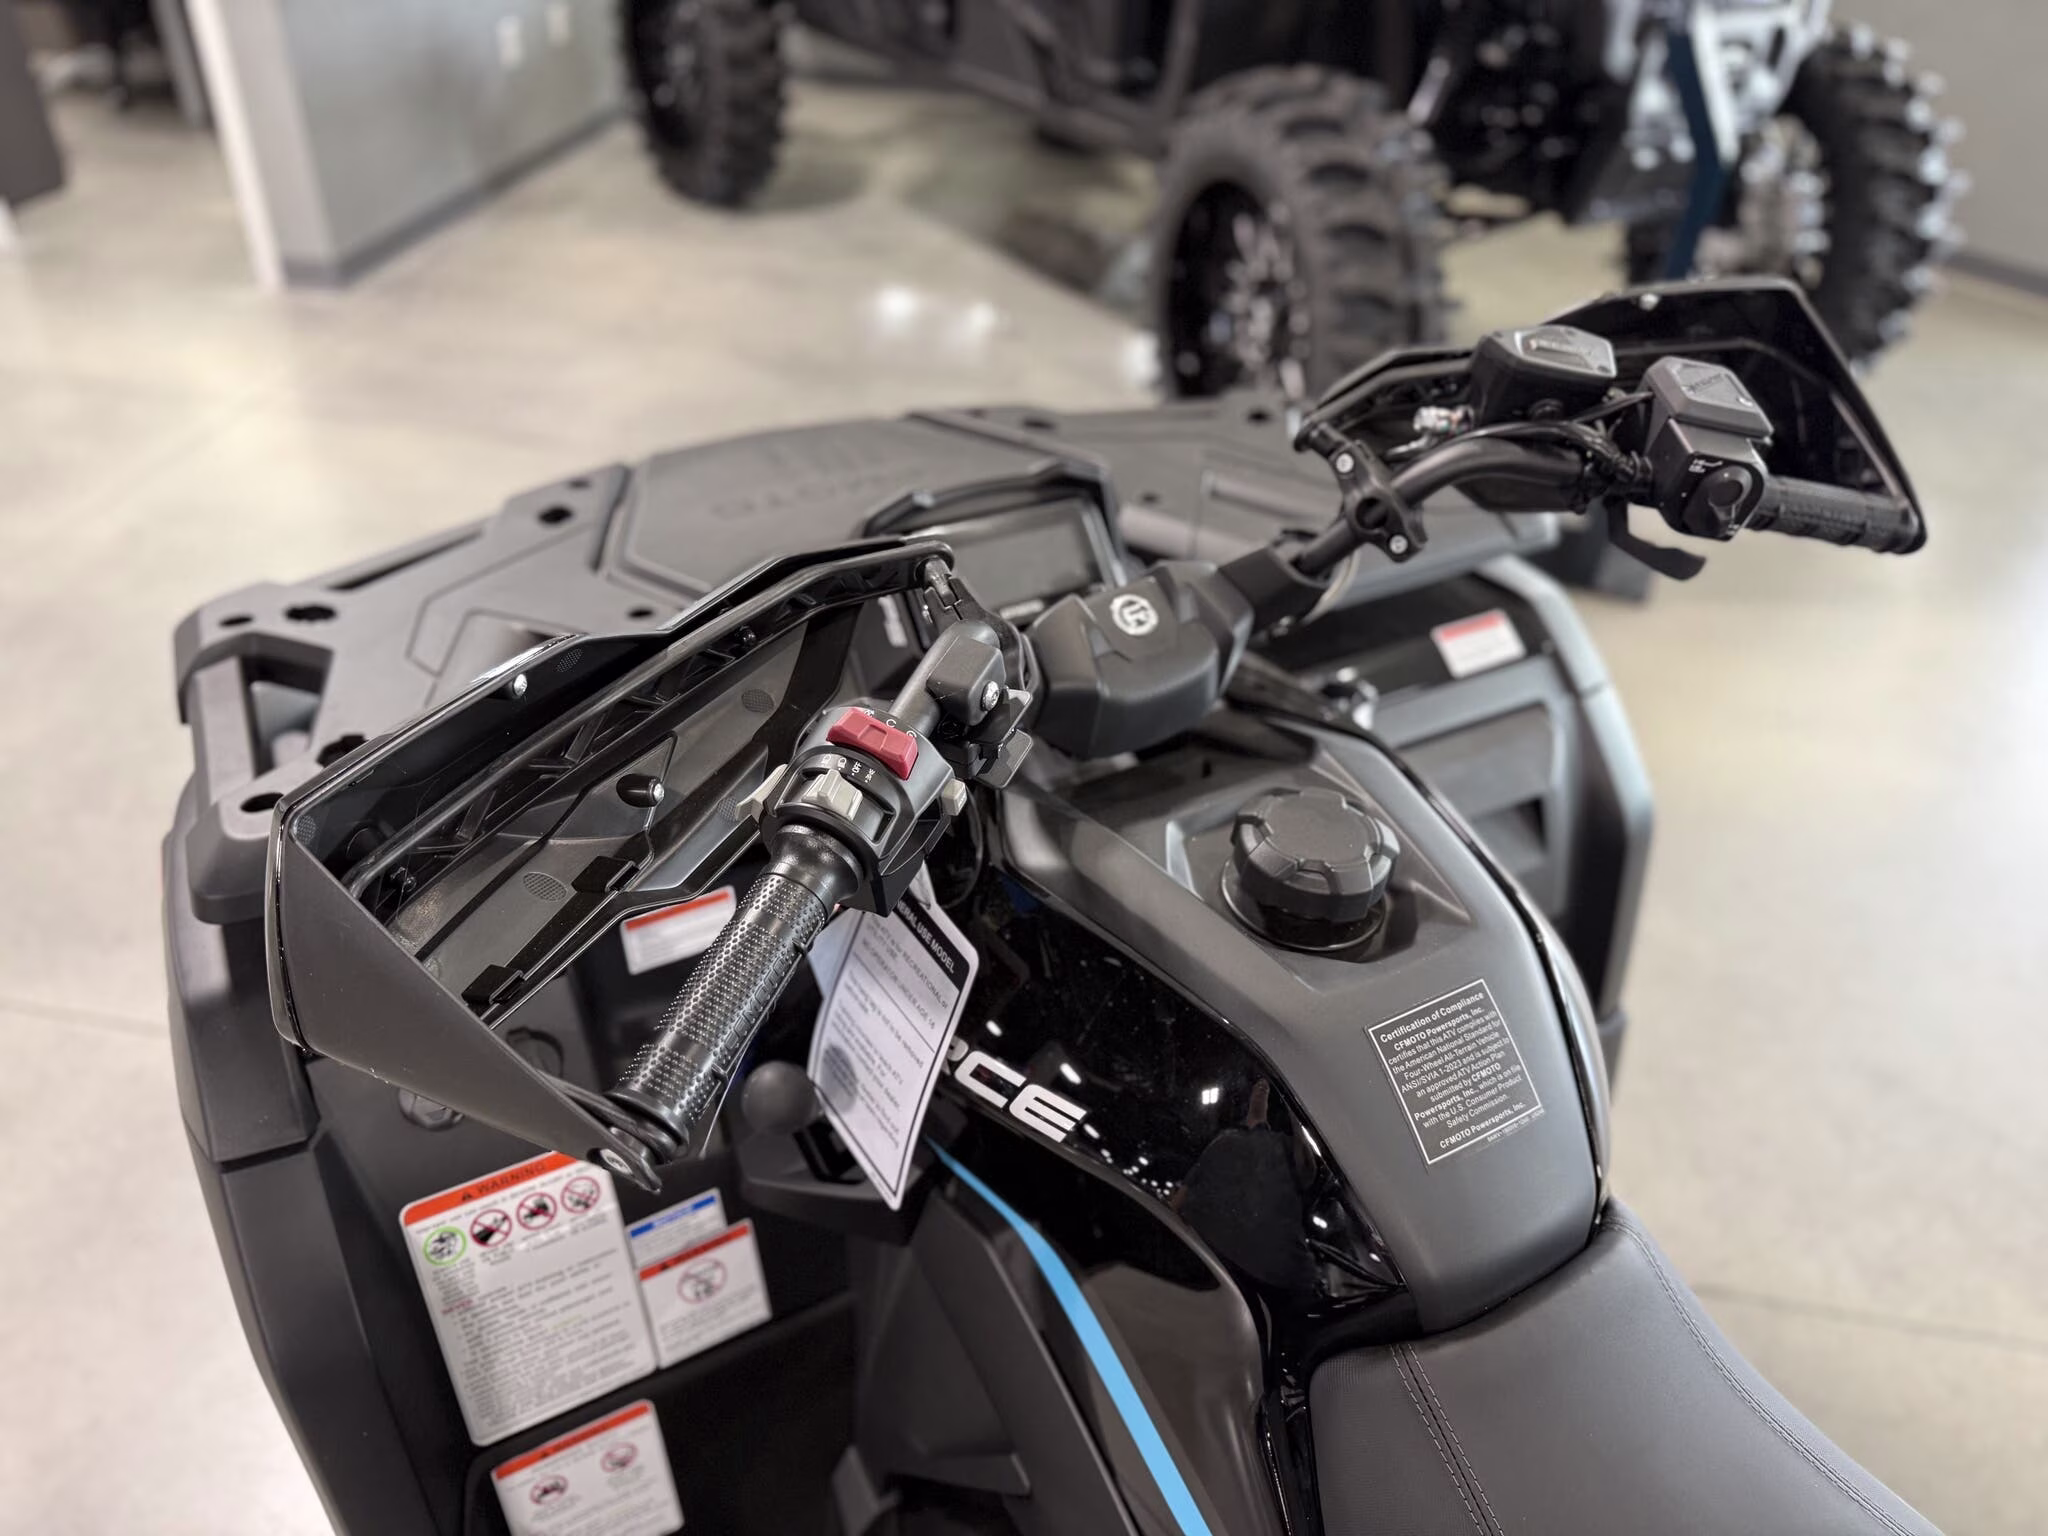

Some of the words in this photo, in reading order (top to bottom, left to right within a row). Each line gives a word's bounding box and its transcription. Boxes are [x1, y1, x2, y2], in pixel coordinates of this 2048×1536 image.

[852, 761, 863, 774] OFF
[917, 922, 933, 943] USE
[930, 940, 955, 974] MODEL
[901, 949, 943, 1003] RECREATIONAL
[1380, 1016, 1431, 1042] Certification
[1431, 1010, 1440, 1020] of
[1439, 992, 1483, 1016] Compliance
[1388, 1048, 1416, 1065] certifies
[1415, 1041, 1430, 1052] that
[1429, 1036, 1442, 1045] this
[1442, 1028, 1455, 1040] ATV
[1456, 1017, 1484, 1033] complies
[1484, 1010, 1496, 1020] with
[1393, 1031, 1426, 1050] CFMOTO
[1425, 1013, 1471, 1036] Powersports,
[1470, 1006, 1484, 1015] Inc.
[1392, 1065, 1405, 1073] the
[1405, 1049, 1437, 1068] American
[1436, 1035, 1464, 1053] National
[1463, 1022, 1492, 1041] Standard
[1491, 1019, 1500, 1027] for
[1401, 1070, 1439, 1093] ANSI/SVIA
[1438, 1059, 1462, 1074] 1-2023
[1462, 1052, 1475, 1064] and
[1480, 1039, 1503, 1055] subject
[1403, 1056, 1444, 1080] Four-Wheel
[1444, 1042, 1477, 1061] All-Terrain
[1475, 1031, 1499, 1045] Vehicle
[1413, 1094, 1463, 1120] Powersports,
[1478, 1076, 1497, 1089] which
[1502, 1069, 1511, 1077] on
[1510, 1064, 1521, 1072] file
[1416, 1089, 1426, 1097] an
[1426, 1072, 1457, 1092] approved
[1457, 1065, 1470, 1077] ATV
[1470, 1057, 1491, 1071] Action
[1489, 1050, 1505, 1061] Plan
[1429, 1081, 1463, 1102] submitted
[1461, 1078, 1471, 1086] by
[1471, 1062, 1500, 1081] CFMOTO
[1422, 1116, 1438, 1127] with
[1437, 1111, 1450, 1120] the
[1449, 1103, 1465, 1114] U.S.
[1465, 1086, 1497, 1107] Consumer
[1497, 1073, 1522, 1090] Product
[1446, 1113, 1468, 1128] Safety
[1439, 1128, 1470, 1148] CFMOTO
[1470, 1108, 1513, 1133] Powersports,
[1512, 1102, 1525, 1111] Inc.
[477, 1162, 547, 1195] WARNING
